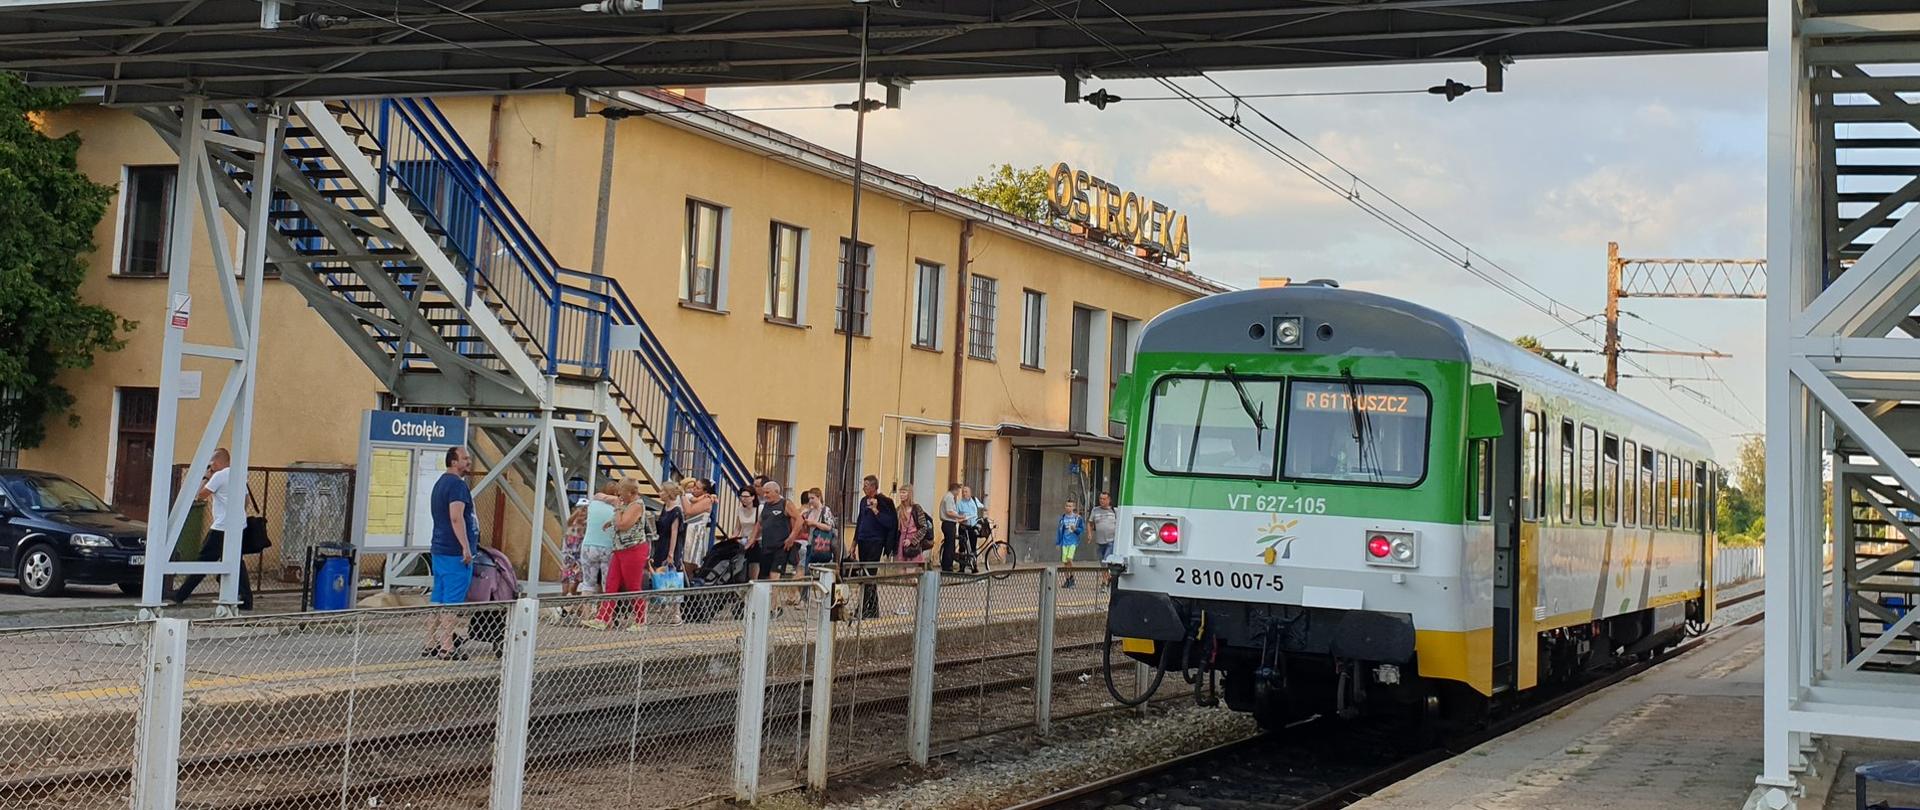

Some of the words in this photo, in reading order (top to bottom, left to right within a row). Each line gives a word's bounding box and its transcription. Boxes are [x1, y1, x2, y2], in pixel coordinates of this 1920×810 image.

[1306, 392, 1316, 408] R
[1319, 393, 1336, 409] 61
[392, 419, 445, 441] Ostrołęka
[1228, 493, 1251, 510] VT
[1256, 495, 1326, 514] 627-105
[1174, 567, 1186, 584] 2
[1191, 569, 1224, 587] 810
[1230, 572, 1284, 592] 007-5
